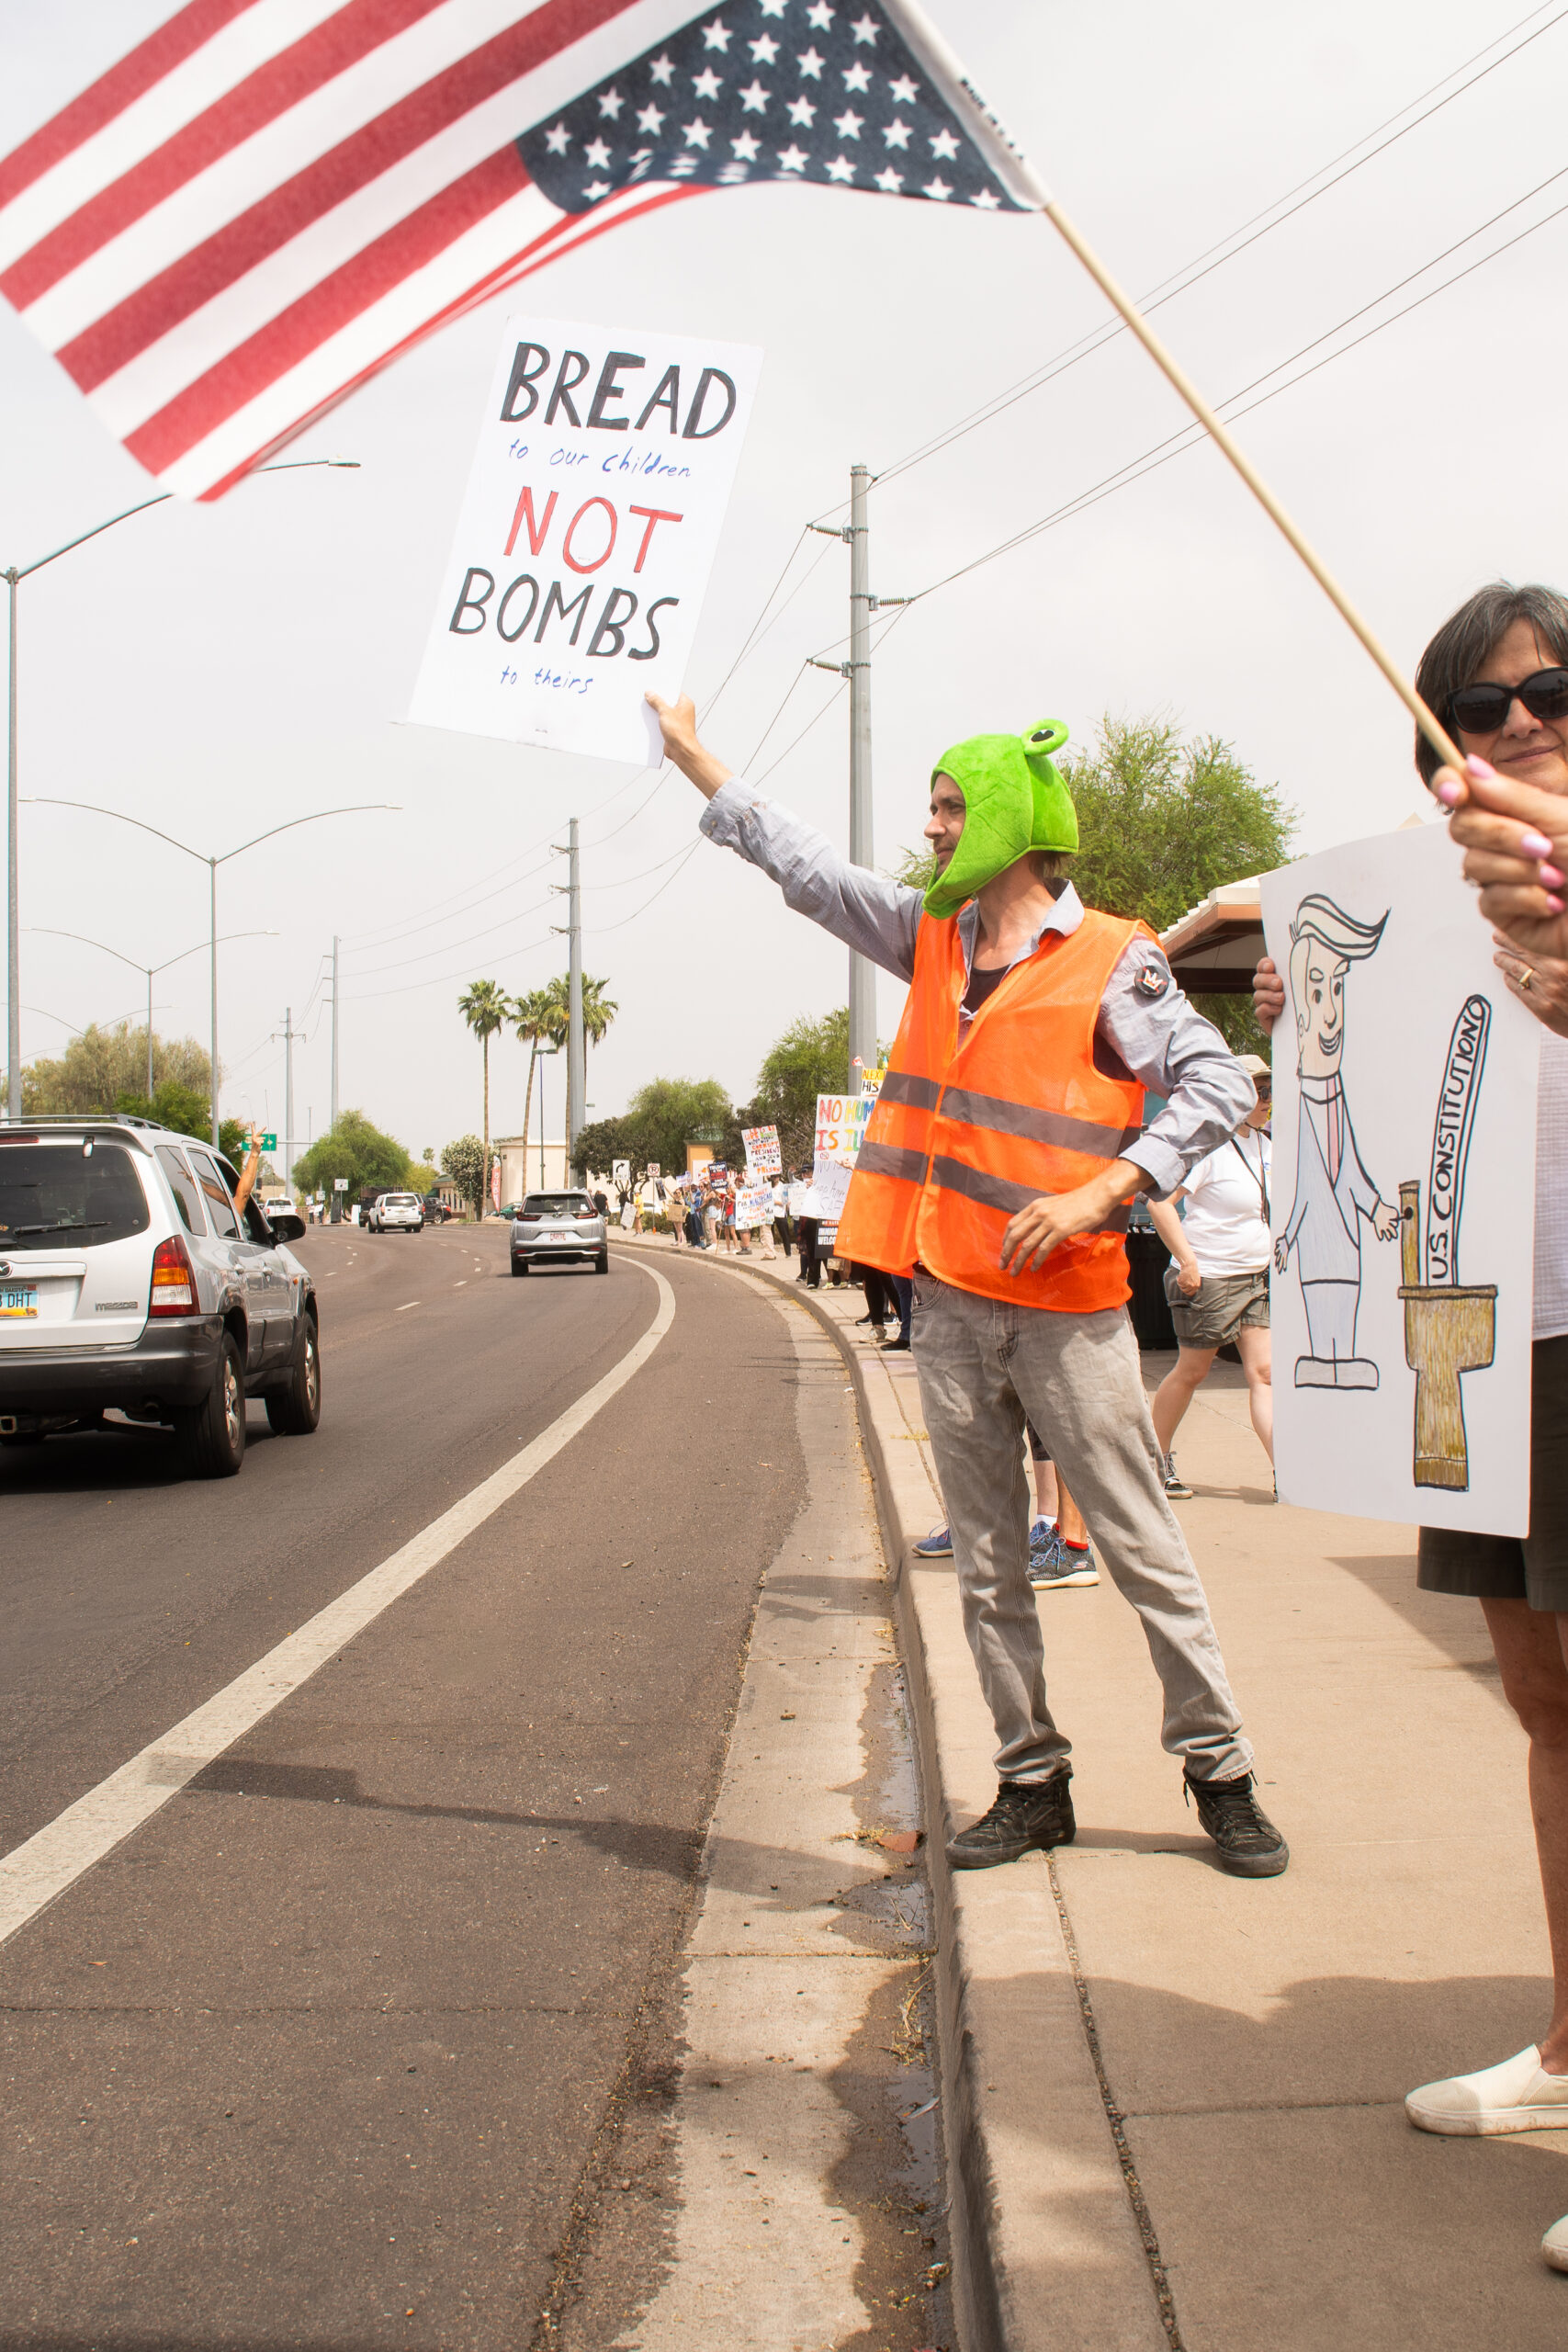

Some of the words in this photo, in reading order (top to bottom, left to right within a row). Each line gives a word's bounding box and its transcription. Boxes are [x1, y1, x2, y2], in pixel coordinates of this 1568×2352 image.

[500, 342, 736, 439] BREAD
[509, 438, 529, 458] to
[549, 447, 589, 466] our
[602, 446, 692, 478] children
[503, 486, 683, 574] NOT
[449, 567, 680, 661] BOMBS
[500, 665, 517, 685] to
[535, 669, 594, 694] theirs
[862, 1080, 879, 1092] HIS
[819, 1099, 842, 1123] NO
[1432, 1015, 1479, 1220] CONSTITUTION
[750, 1147, 780, 1156] PRESIDENT
[816, 1129, 839, 1151] IS
[8, 1293, 32, 1308] DHT
[95, 1301, 139, 1311] mazda
